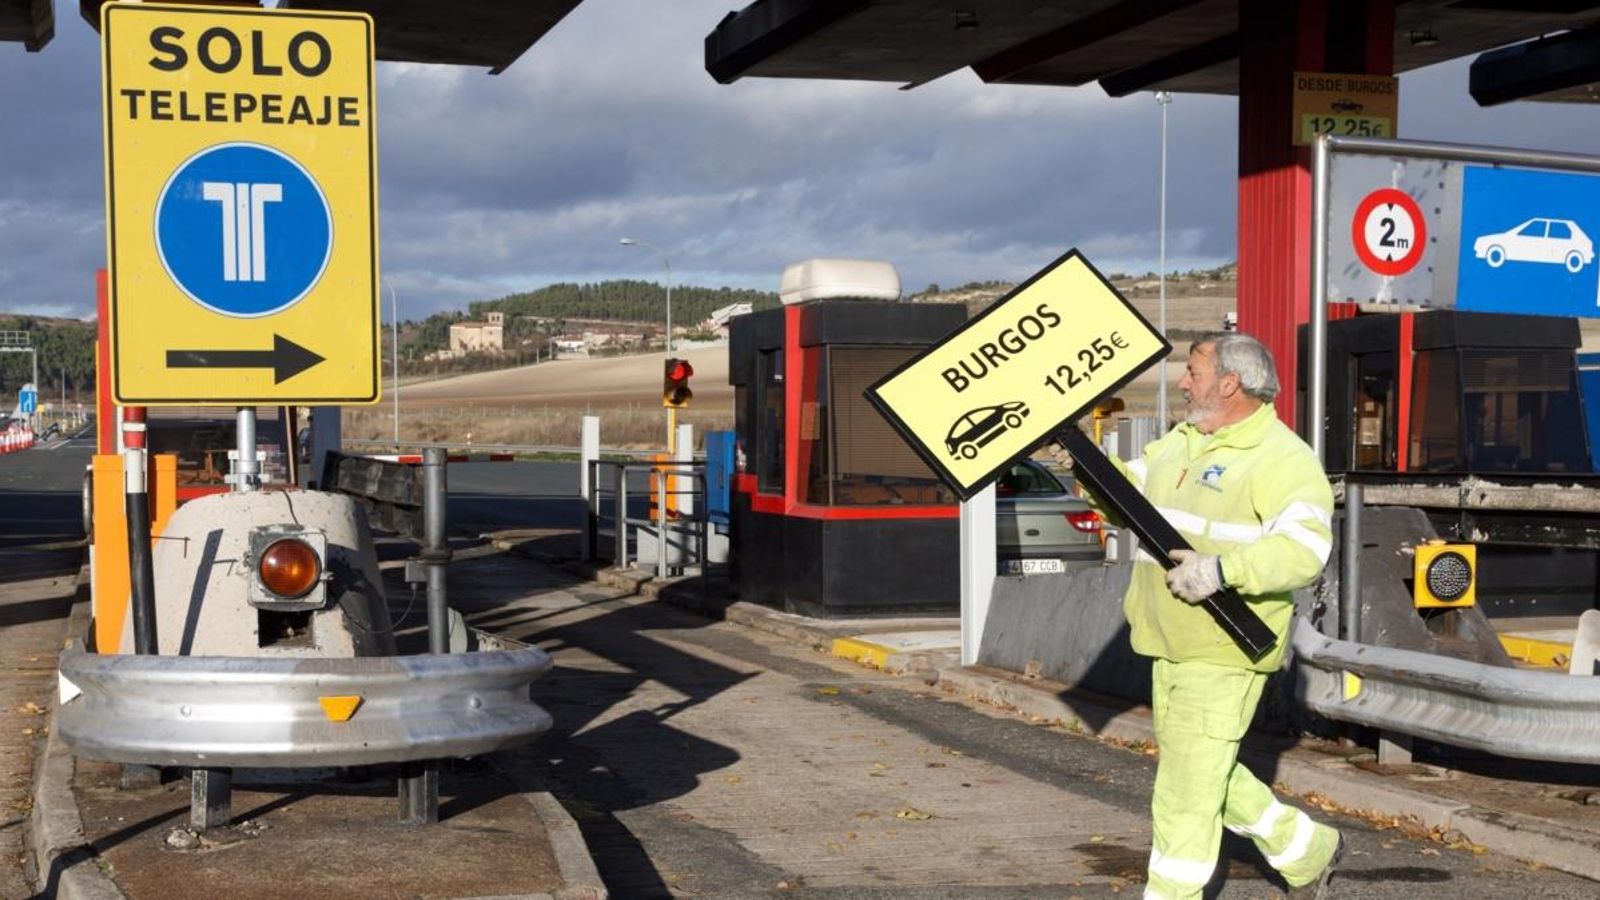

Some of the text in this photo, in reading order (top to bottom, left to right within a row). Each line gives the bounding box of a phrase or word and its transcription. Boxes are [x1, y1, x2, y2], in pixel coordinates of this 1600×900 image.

[148, 26, 332, 77] SOLO
[120, 89, 361, 126] TELEPEAJE
[1298, 78, 1394, 95] DESDE BURGOS
[941, 303, 1061, 393] BURGOS
[1044, 331, 1130, 395] 12,25€
